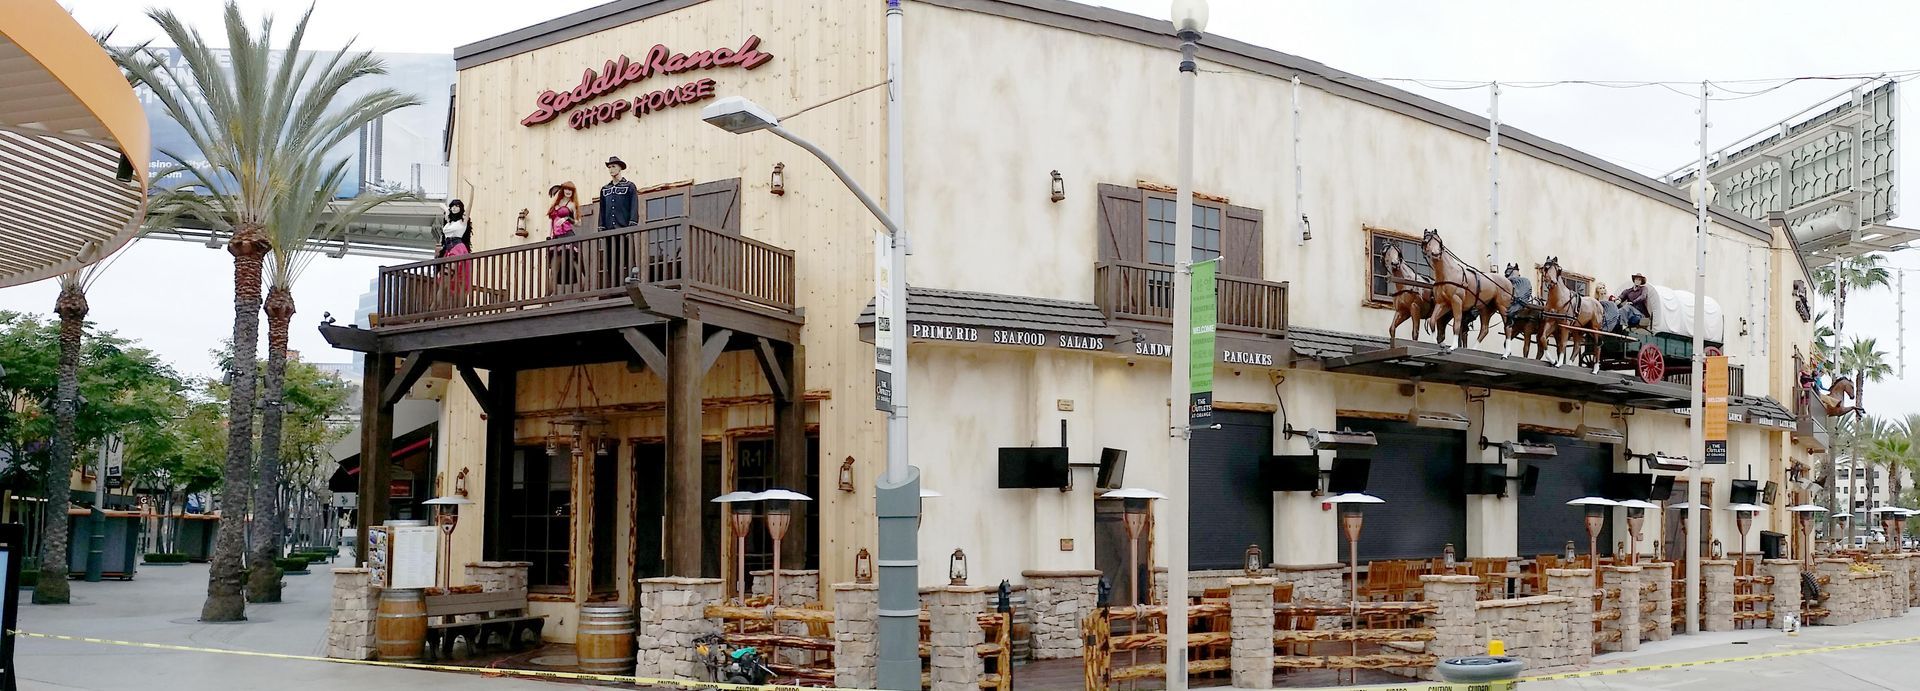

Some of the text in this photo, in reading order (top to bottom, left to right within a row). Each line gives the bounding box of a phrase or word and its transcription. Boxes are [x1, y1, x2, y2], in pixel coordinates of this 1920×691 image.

[568, 77, 717, 130] CHOP HOUSE
[148, 159, 172, 168] sino
[912, 324, 1273, 366] PRIME RIB SEAFOOD SALADS SANDW PANCAKES
[1191, 404, 1212, 413] OUTLETS
[742, 449, 761, 467] R-1
